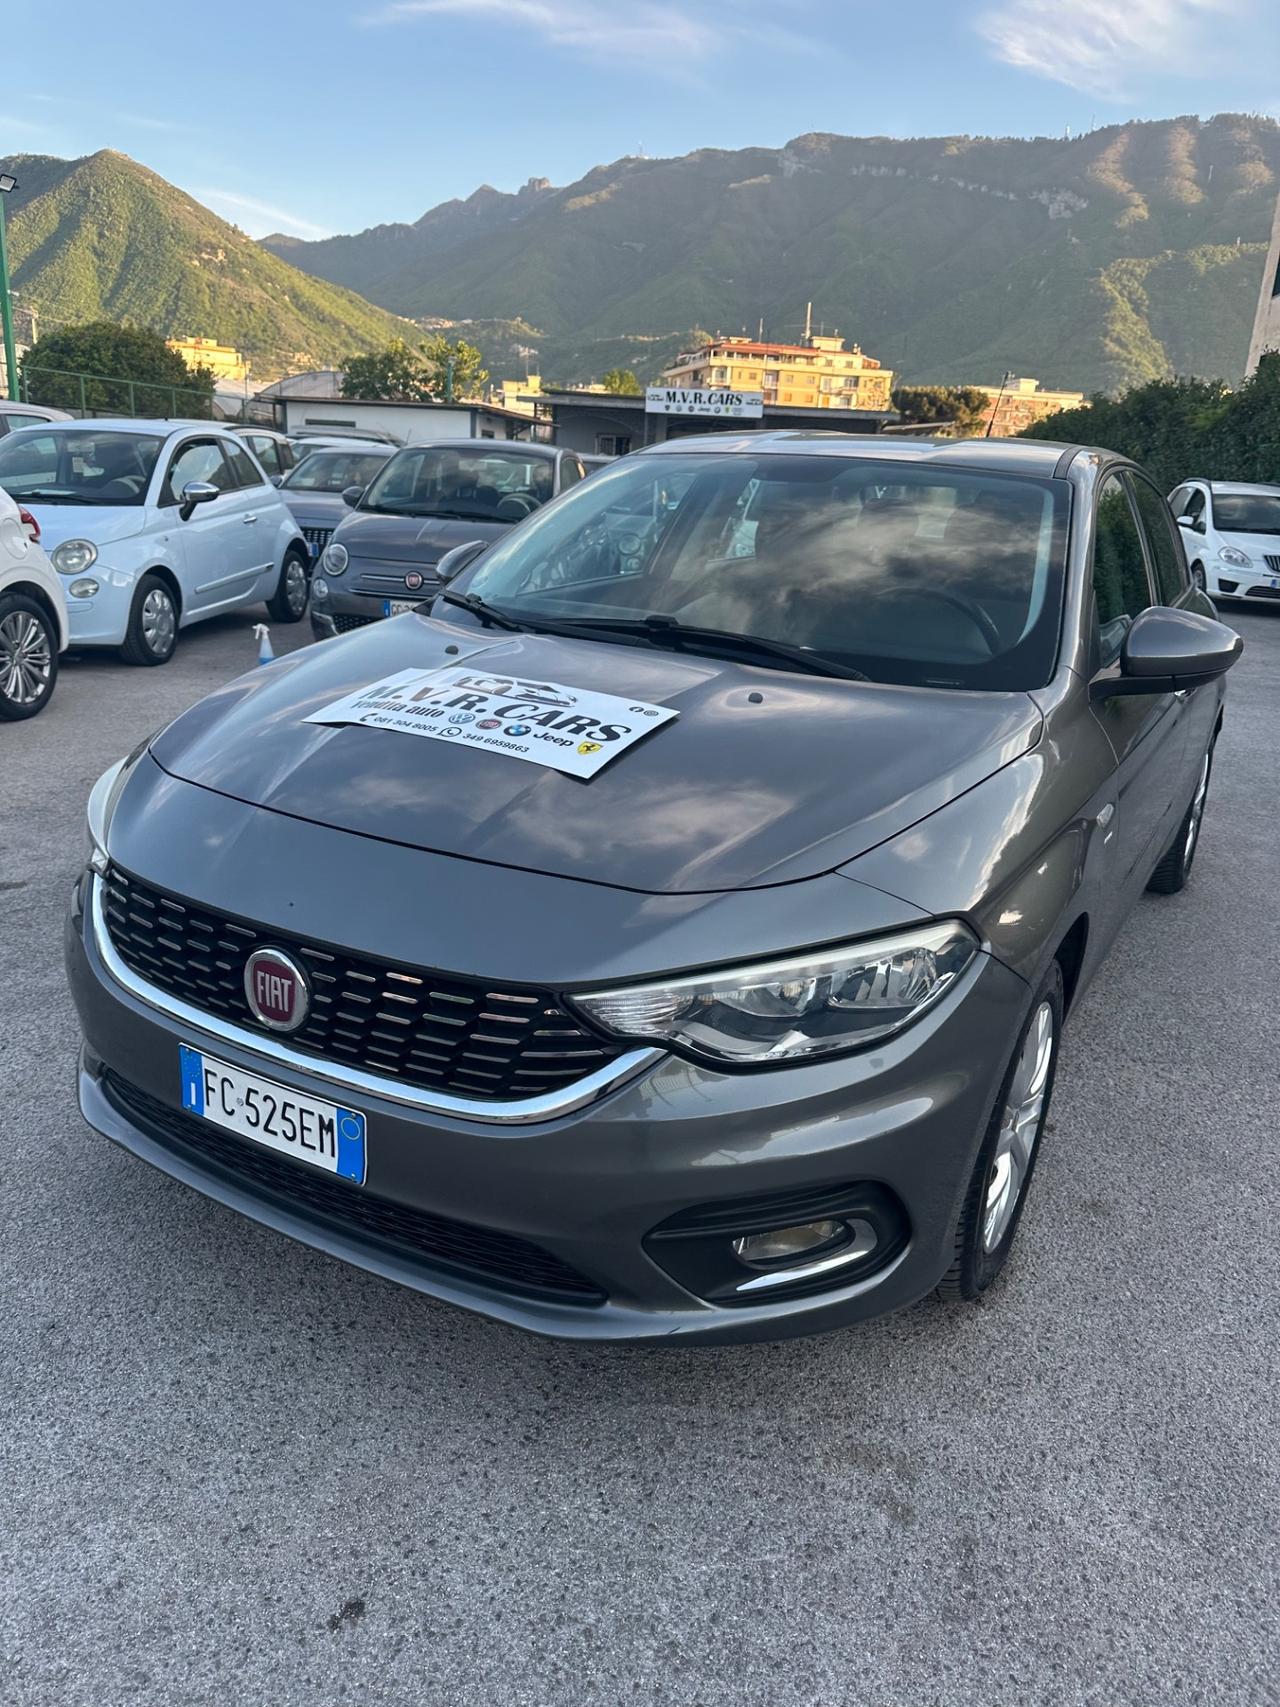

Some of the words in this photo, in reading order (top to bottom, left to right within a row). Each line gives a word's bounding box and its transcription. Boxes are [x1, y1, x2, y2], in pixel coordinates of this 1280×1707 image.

[405, 706, 445, 718] auto
[393, 719, 411, 727] 304
[411, 722, 439, 732] 8005
[462, 733, 483, 742] 349
[483, 737, 530, 753] 6959863
[533, 731, 575, 748] Jeep
[256, 970, 293, 1012] FIAT
